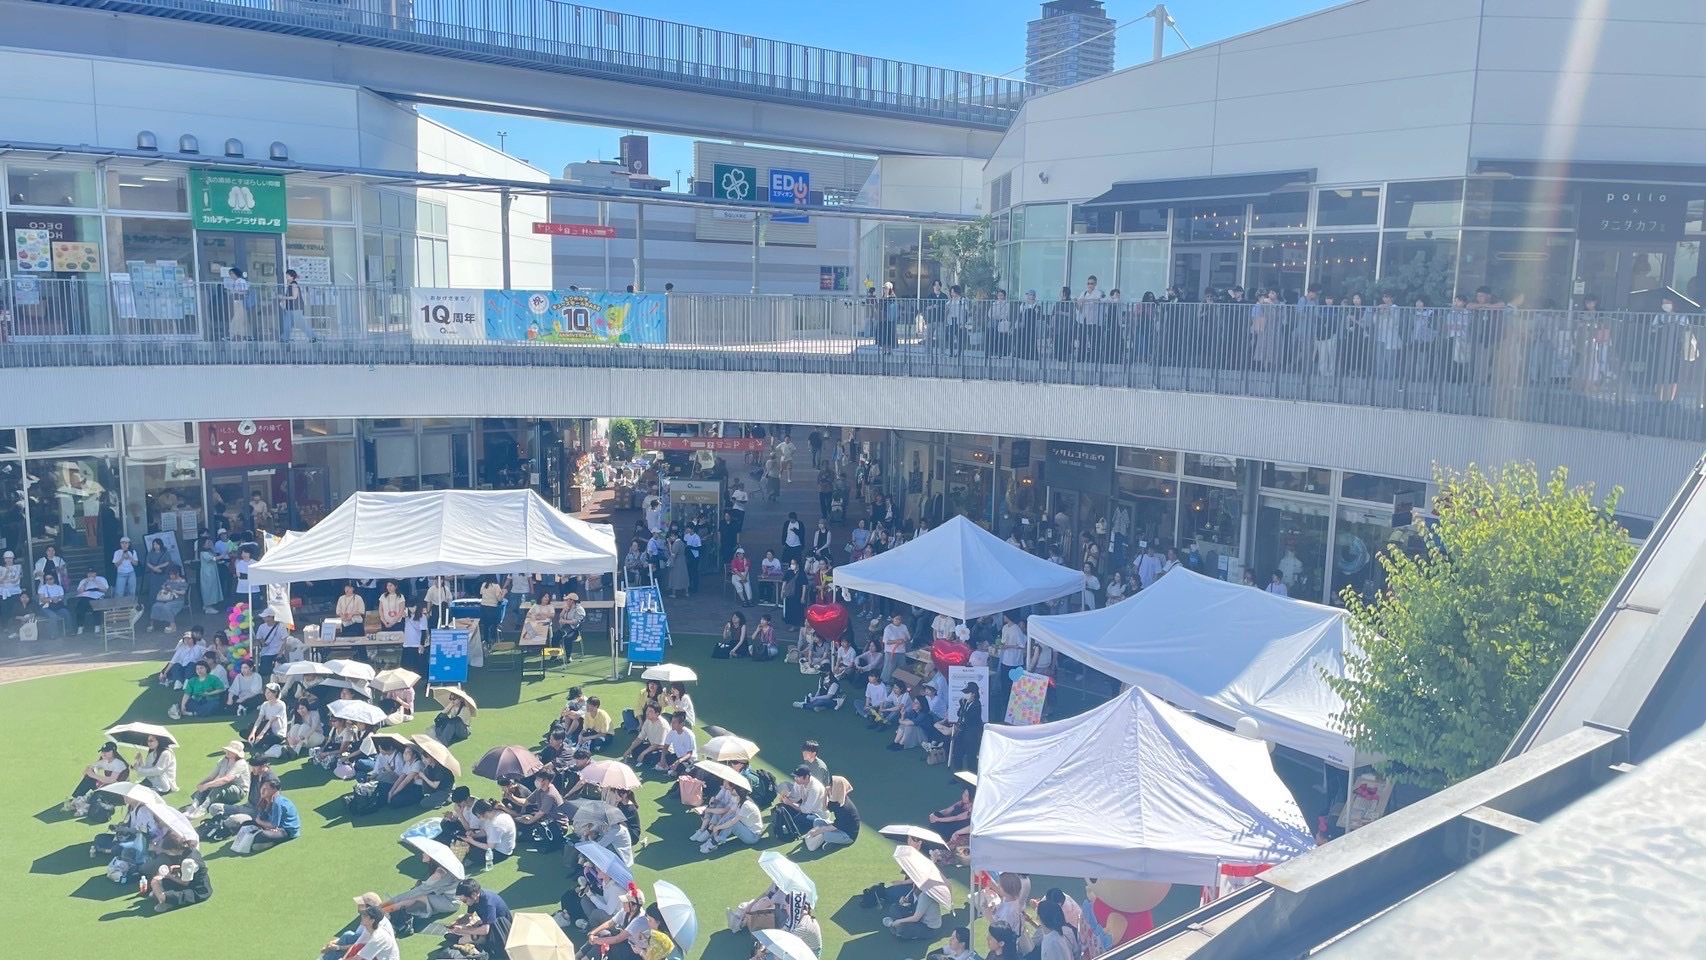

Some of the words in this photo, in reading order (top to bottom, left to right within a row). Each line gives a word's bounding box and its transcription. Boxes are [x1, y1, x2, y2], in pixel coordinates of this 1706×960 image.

[773, 190, 794, 198] エディオン
[1606, 192, 1667, 203] pollo
[202, 215, 281, 227] カルチャープラザ森ノ宮
[1600, 219, 1666, 233] タニタカフェ
[532, 296, 544, 307] 祝
